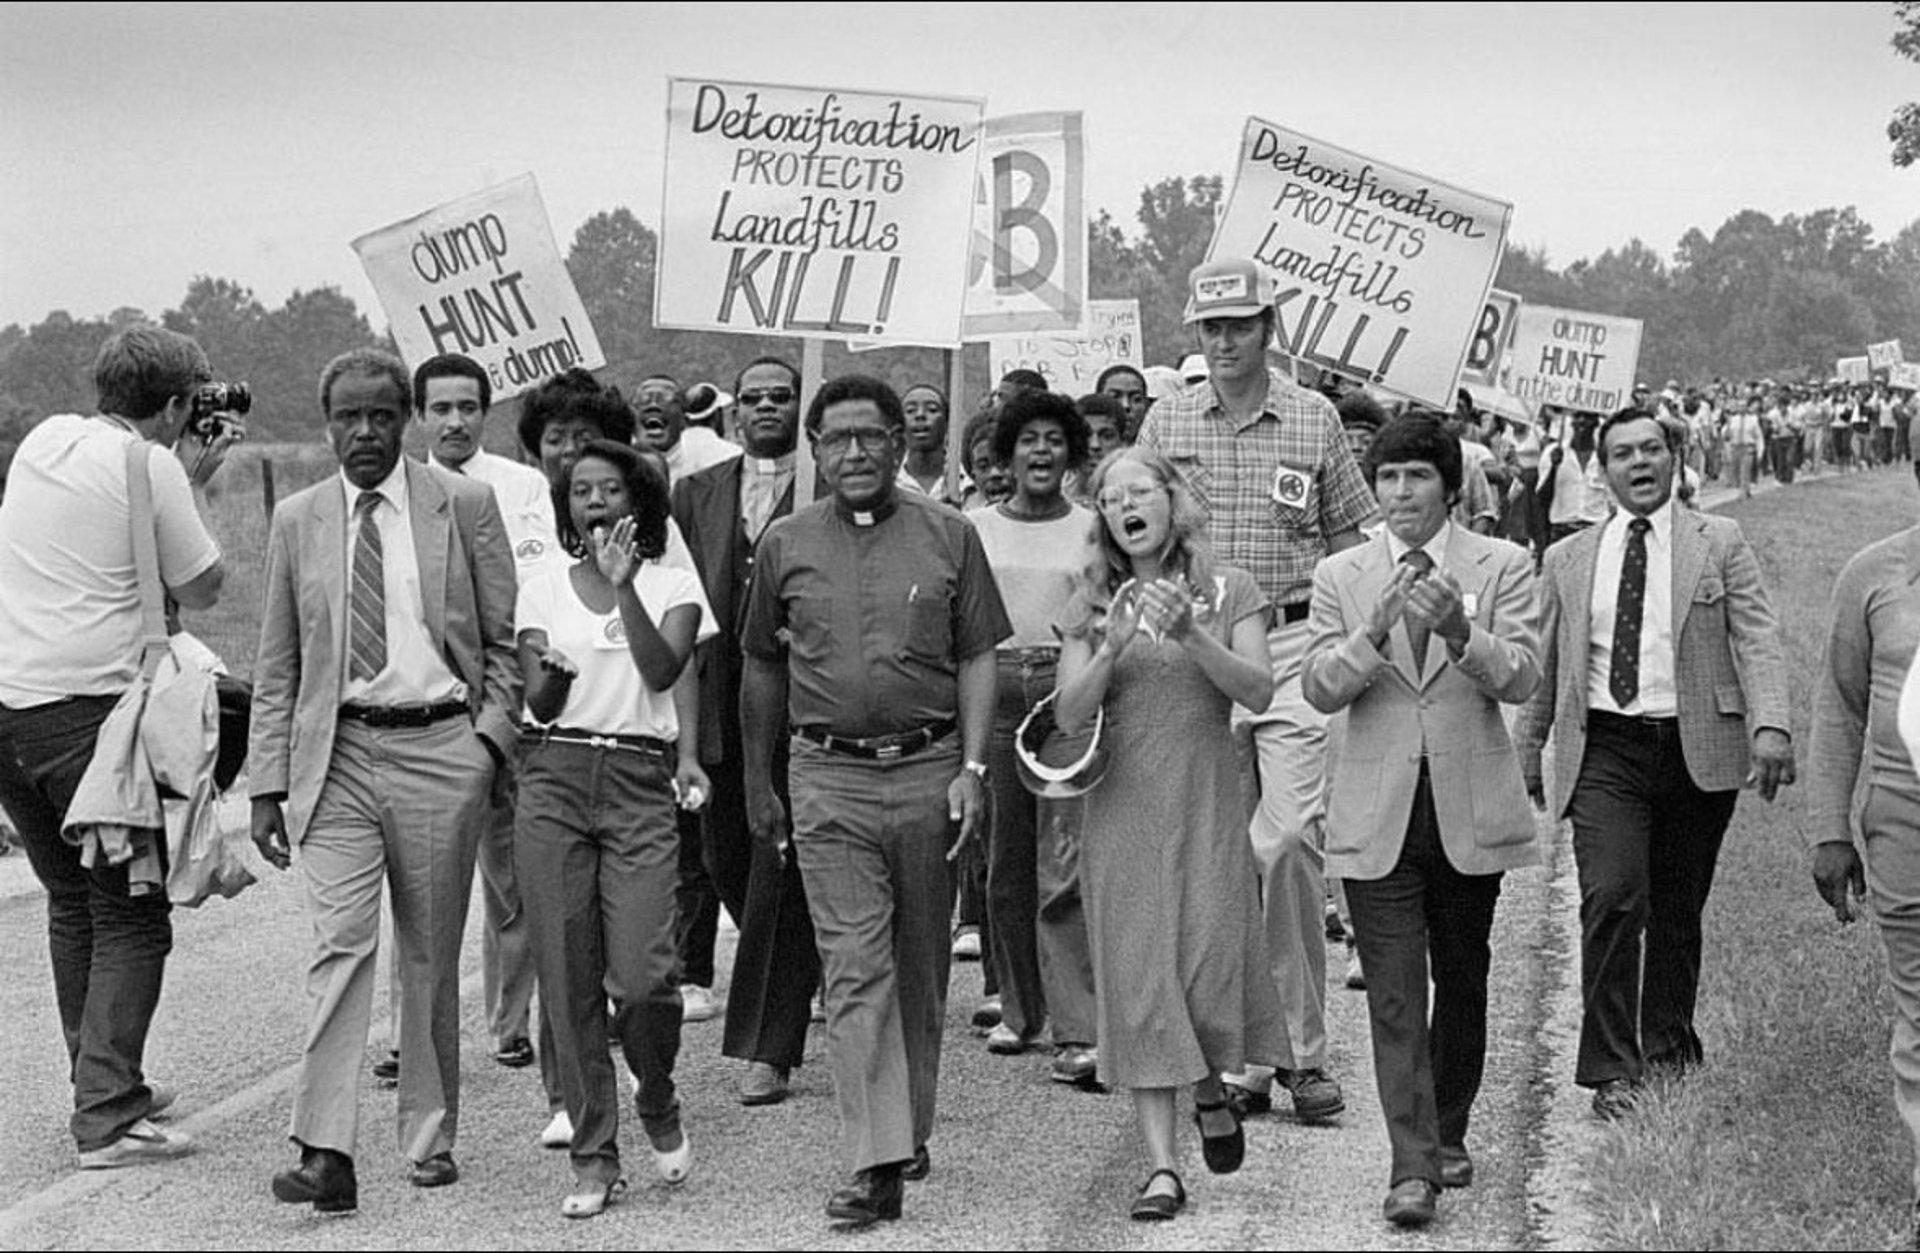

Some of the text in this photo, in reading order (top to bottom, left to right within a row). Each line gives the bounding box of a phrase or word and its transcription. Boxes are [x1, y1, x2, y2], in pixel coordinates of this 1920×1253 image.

[693, 84, 976, 153] Detoxification
[732, 148, 905, 192] PROTECTS
[1251, 127, 1486, 239] Detoxification
[411, 213, 507, 284] dump
[711, 190, 899, 254] Landfills
[1273, 182, 1426, 259] PROTECTS
[717, 247, 901, 335] KILL!
[1253, 221, 1415, 314] Landfills
[419, 270, 537, 356] HUNT
[1552, 318, 1607, 351] dump
[503, 316, 584, 386] dump!
[1538, 345, 1606, 383] HUNT
